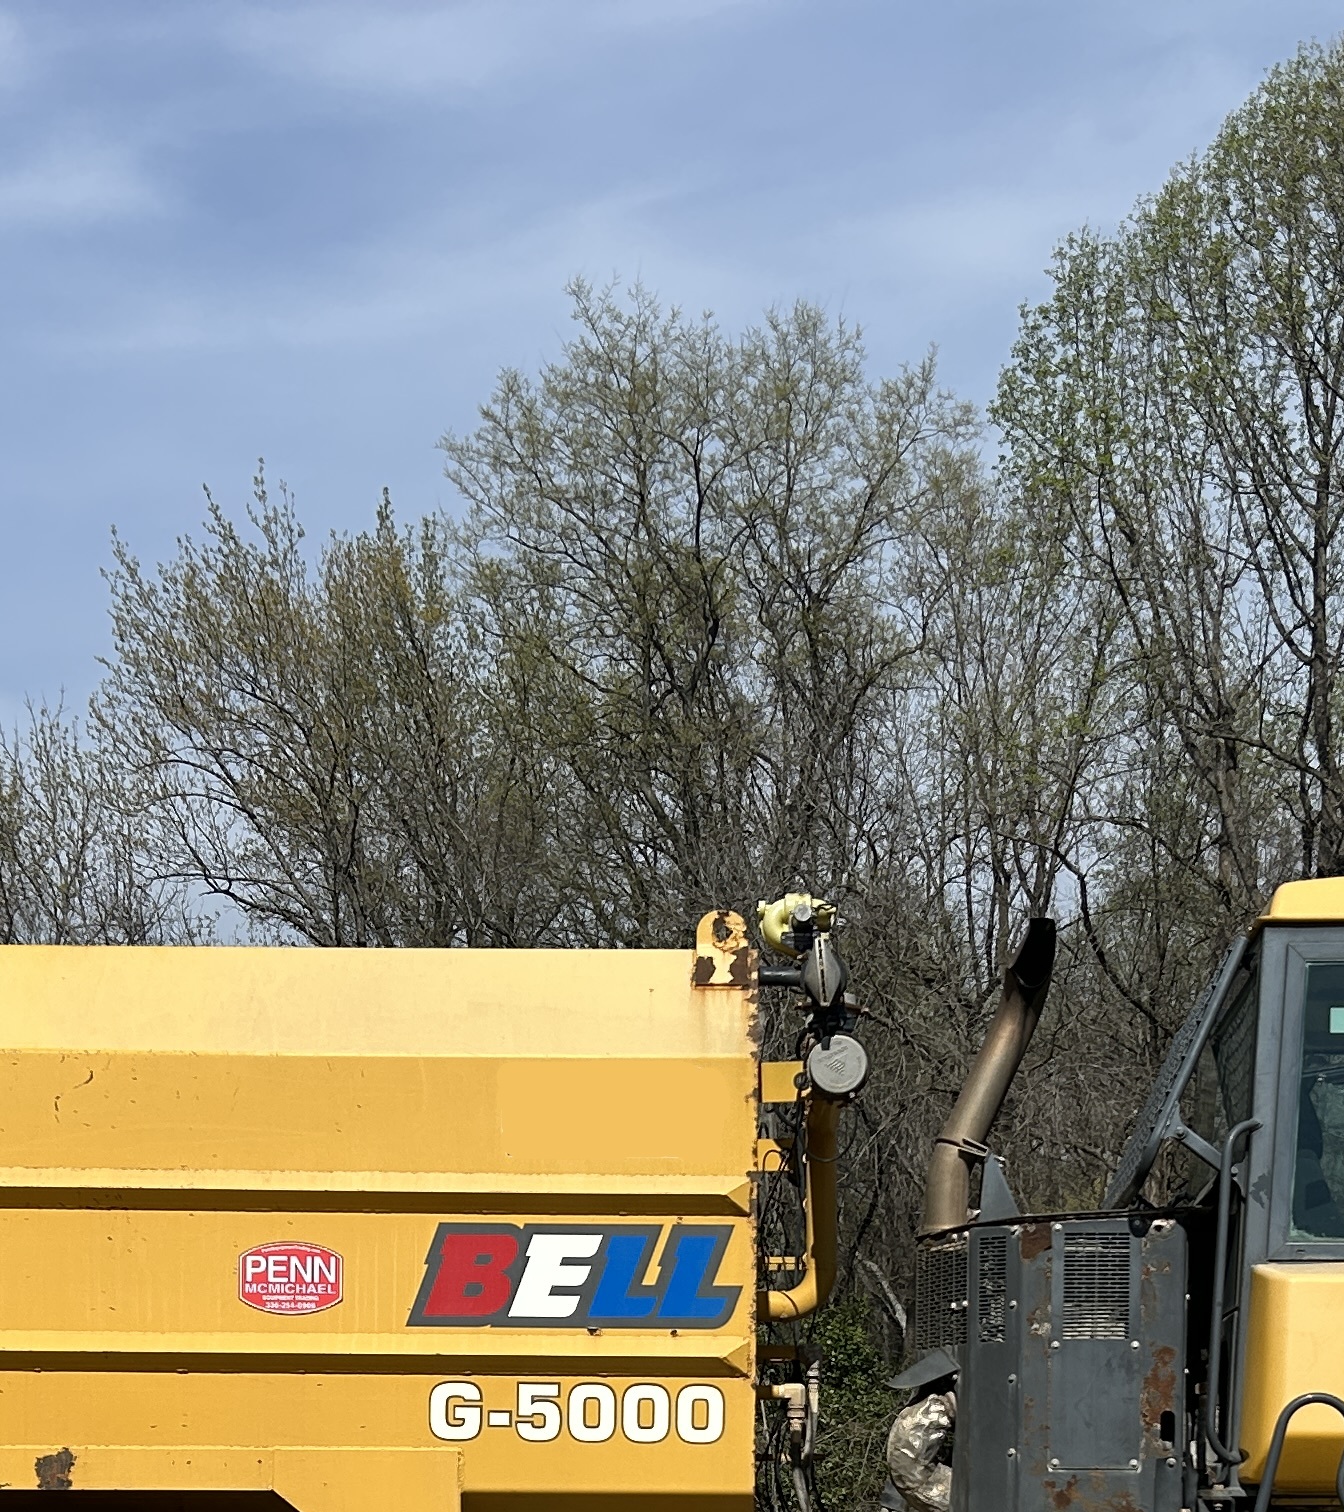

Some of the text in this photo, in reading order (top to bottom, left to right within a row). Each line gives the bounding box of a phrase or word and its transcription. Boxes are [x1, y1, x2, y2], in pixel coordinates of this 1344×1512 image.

[244, 1283, 336, 1295] MCMICHAEL
[245, 1255, 336, 1283] PENN
[414, 1227, 739, 1324] BELL
[428, 1381, 725, 1444] G-5000
